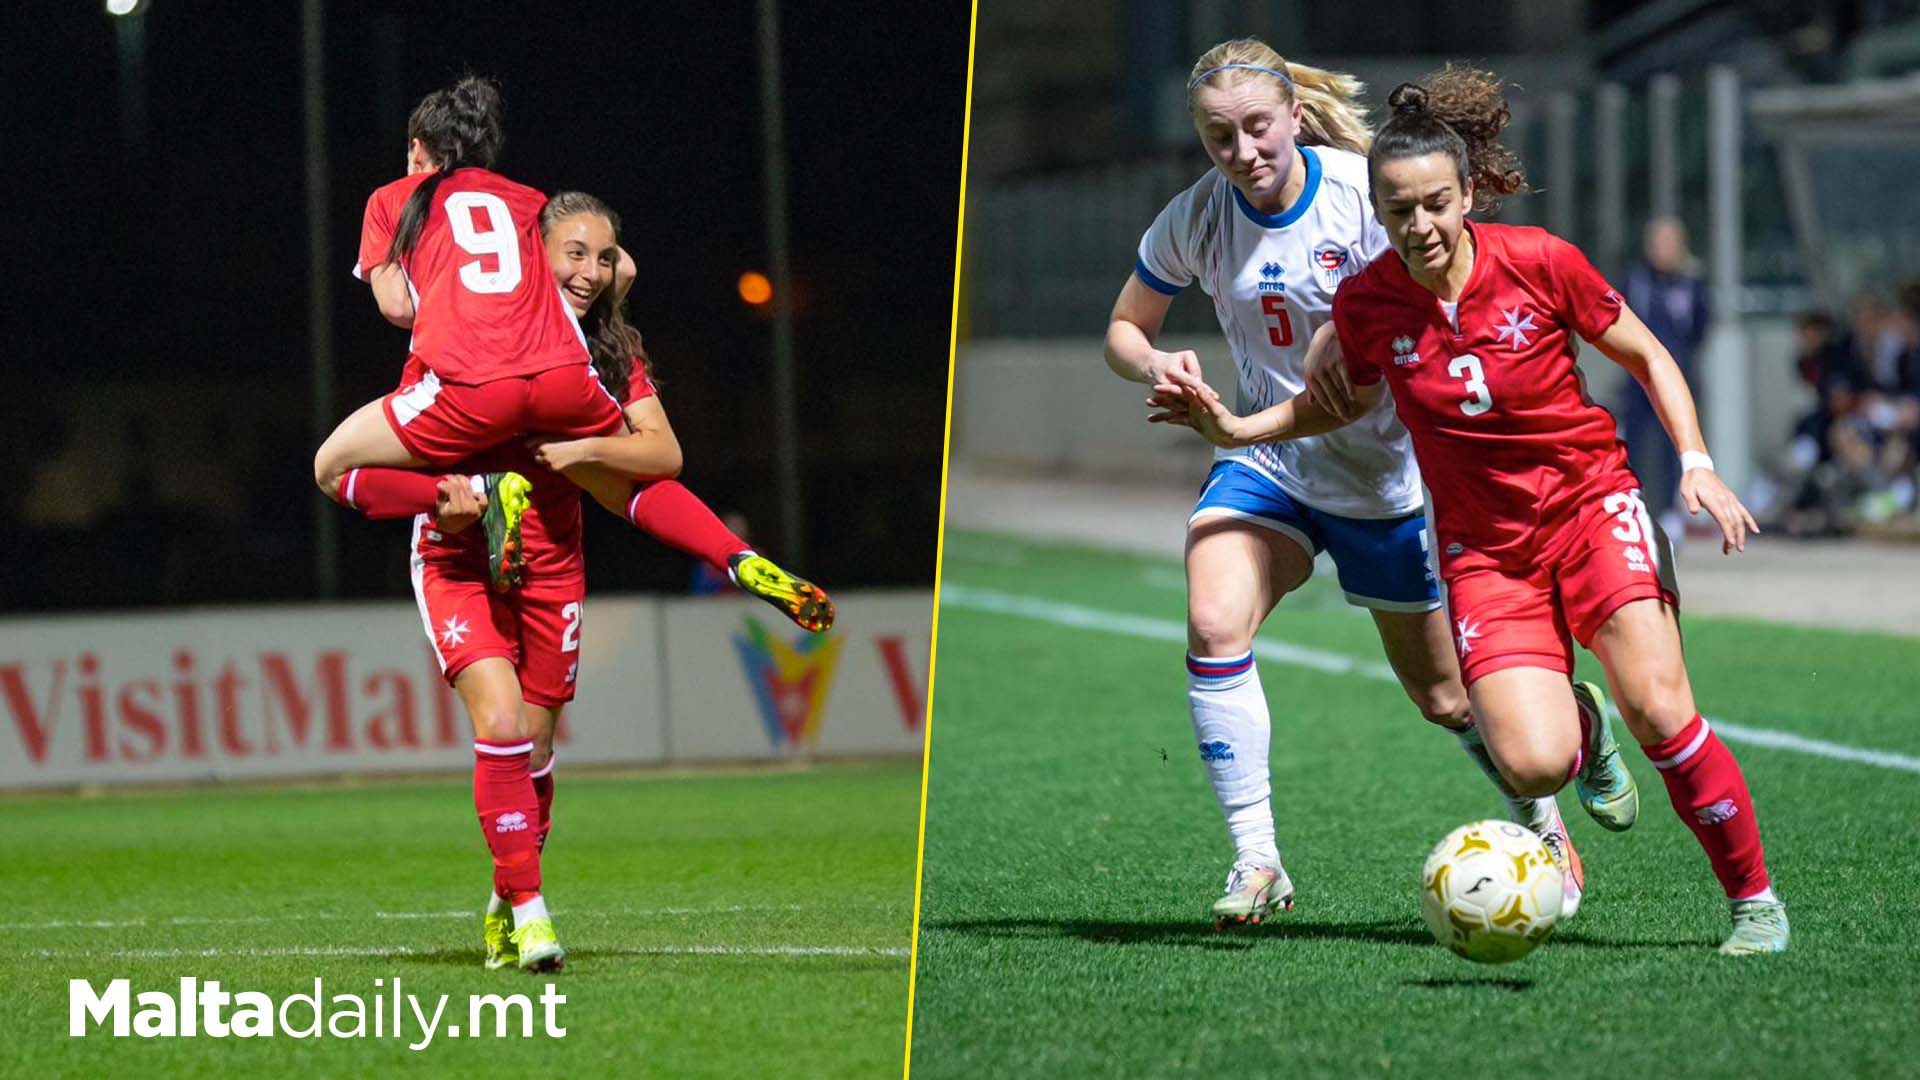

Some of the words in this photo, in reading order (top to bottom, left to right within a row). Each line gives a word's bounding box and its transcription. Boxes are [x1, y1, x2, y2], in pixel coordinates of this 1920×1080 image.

[444, 191, 522, 294] 9
[1261, 295, 1293, 347] 5
[1447, 353, 1493, 417] 3
[0, 640, 572, 767] VisitMal
